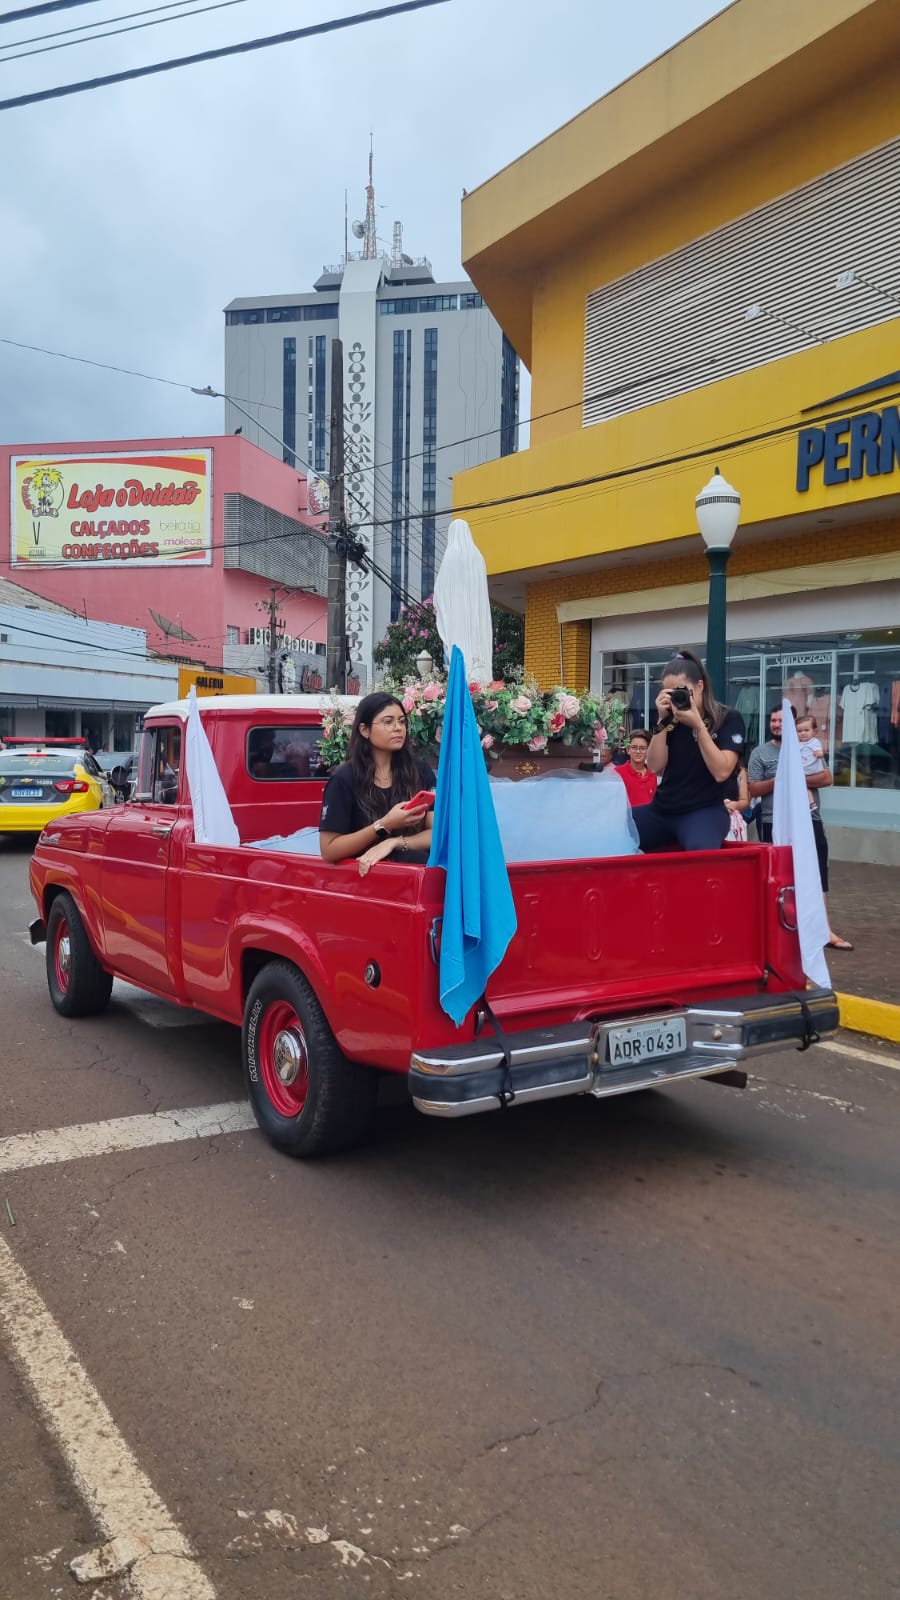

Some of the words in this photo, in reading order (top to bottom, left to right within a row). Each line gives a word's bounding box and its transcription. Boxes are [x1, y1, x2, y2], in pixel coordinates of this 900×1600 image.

[67, 483, 115, 512] Loja
[125, 479, 201, 507] Doidão
[71, 520, 150, 539] CALÇADOS
[62, 539, 159, 560] CONFECÇÕES
[163, 536, 202, 546] moleca
[247, 999, 263, 1082] MICHELIN
